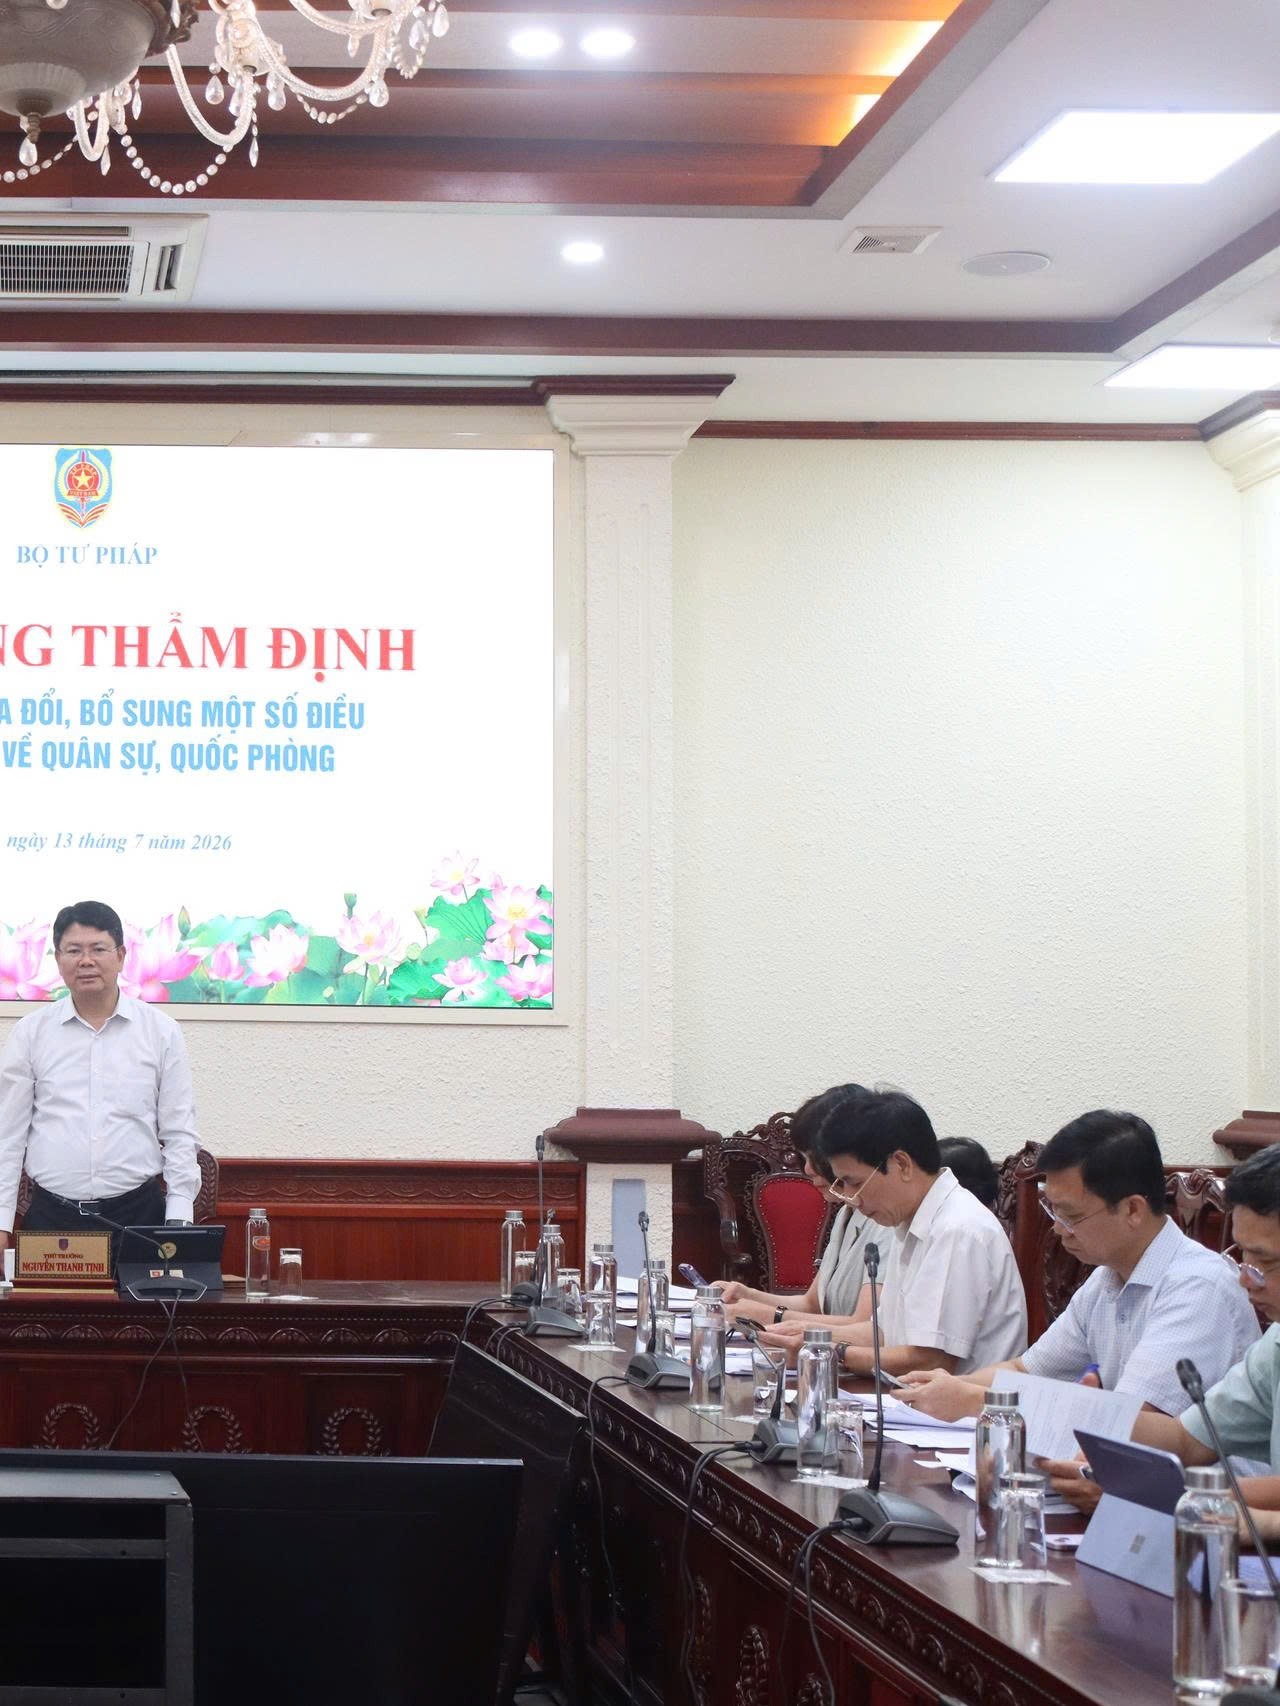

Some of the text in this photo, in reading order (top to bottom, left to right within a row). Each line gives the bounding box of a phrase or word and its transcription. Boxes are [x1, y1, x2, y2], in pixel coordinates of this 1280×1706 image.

[17, 542, 158, 568] BỘ TƯ PHÁP
[72, 611, 249, 669] THẨM
[267, 627, 416, 683] ĐỊNH
[20, 688, 71, 729] ĐỔI,
[79, 688, 114, 726] BỔ
[122, 699, 192, 727] SUNG
[201, 695, 256, 734] MỘT
[264, 692, 299, 729] SỐ
[306, 692, 365, 730] ĐIỀU
[3, 732, 33, 768] VỀ
[42, 735, 111, 772] QUÂN
[120, 740, 161, 775] SỰ,
[170, 733, 239, 773] QUỐC
[248, 737, 335, 772] PHÒNG
[7, 832, 48, 852] ngày
[55, 832, 73, 848] 13
[78, 832, 128, 853] tháng
[135, 833, 145, 849] 7
[148, 834, 186, 850] năm
[191, 834, 233, 851] 2026
[56, 1262, 84, 1272] THANH
